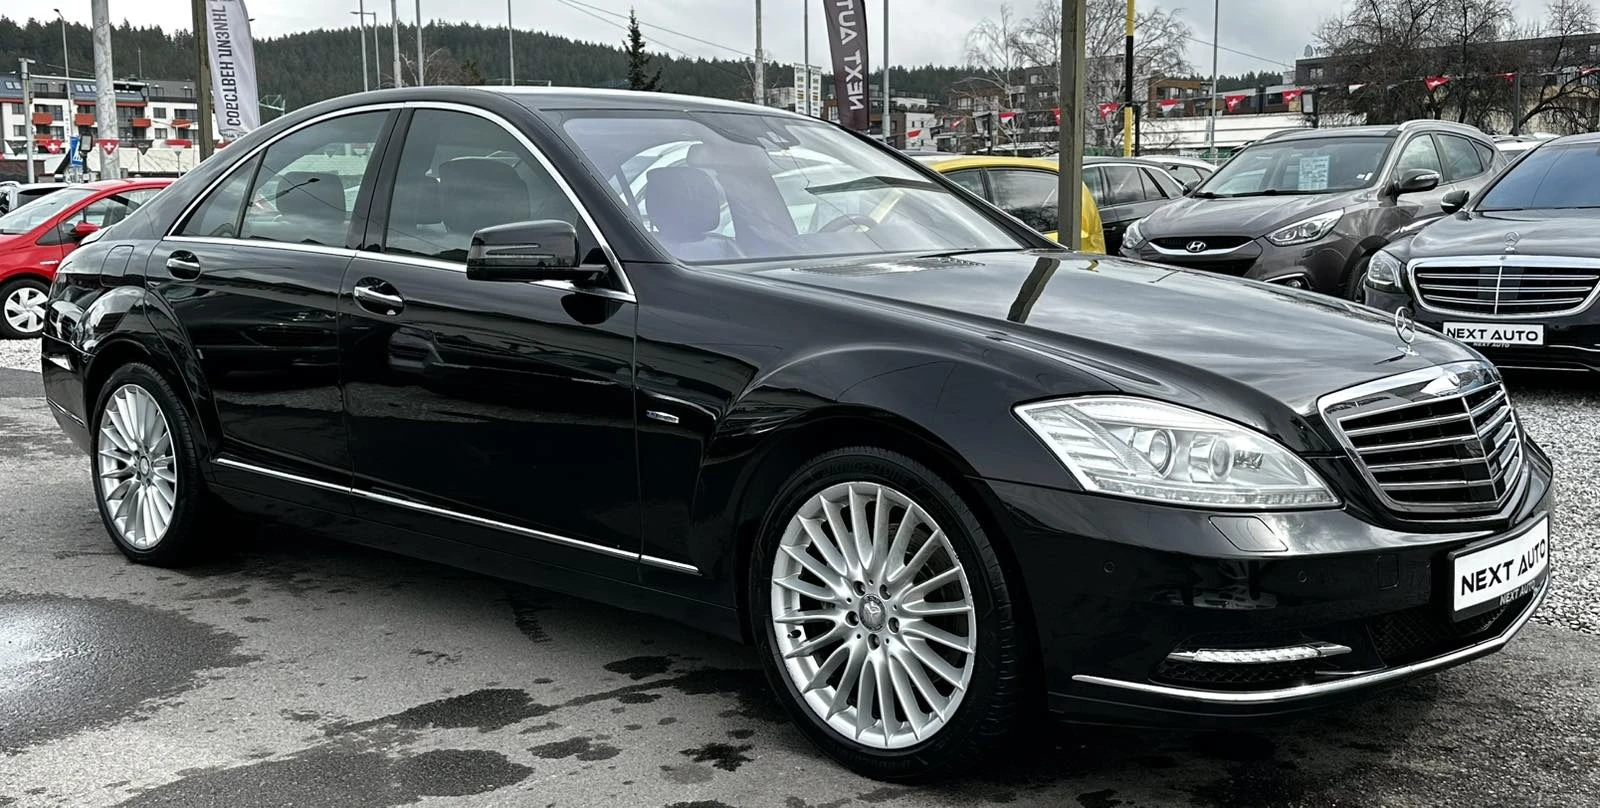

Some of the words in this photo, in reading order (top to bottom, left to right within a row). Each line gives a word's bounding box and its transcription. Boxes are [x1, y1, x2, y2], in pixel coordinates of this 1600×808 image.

[1446, 327, 1487, 339] NEXT
[1490, 329, 1539, 342] AUTO
[1461, 559, 1515, 596] NEXT
[1517, 538, 1546, 577] AUTO
[1499, 588, 1520, 606] NEXT
